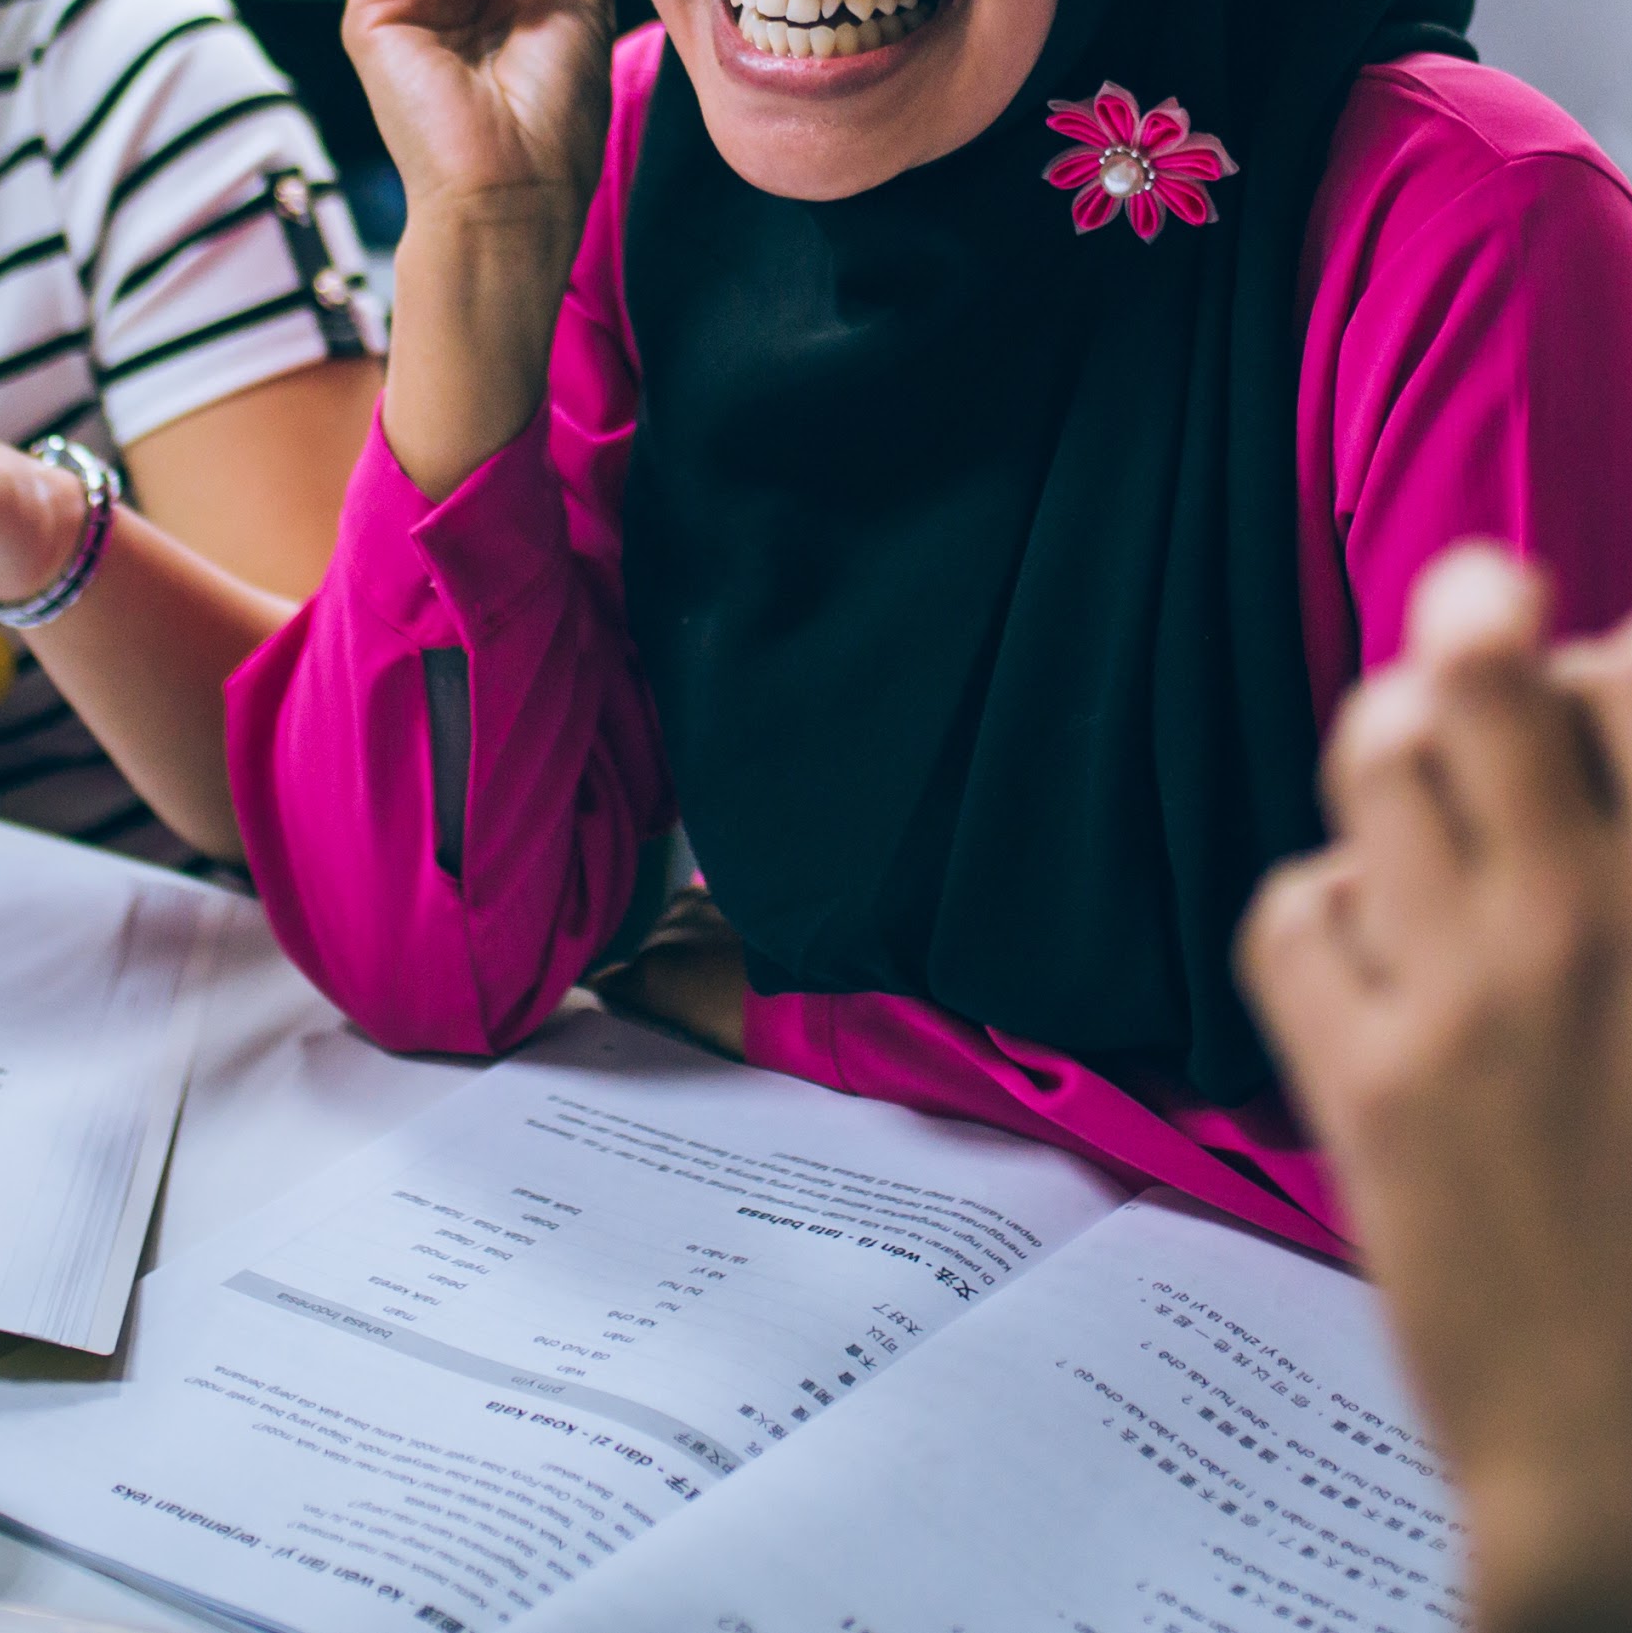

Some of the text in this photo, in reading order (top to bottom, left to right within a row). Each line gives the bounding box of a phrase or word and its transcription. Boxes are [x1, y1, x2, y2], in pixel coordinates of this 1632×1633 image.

[736, 1206, 806, 1230] bahasa
[806, 1224, 844, 1239] tata
[1004, 1219, 1043, 1248] depan
[410, 1243, 452, 1261] mobil
[924, 1238, 984, 1273] pelajaran
[952, 1230, 1013, 1273] kami ingin
[367, 1275, 412, 1297] kereta
[427, 1272, 469, 1291] pelan
[934, 1266, 980, 1302] 文法
[978, 1271, 996, 1286] Di
[275, 1292, 342, 1321] Indonesia
[410, 1291, 442, 1306] naik
[382, 1305, 418, 1322] main
[872, 1303, 924, 1337] 太好了
[341, 1315, 394, 1340] bahasa
[865, 1325, 899, 1355] 可以
[485, 1400, 529, 1420] kata
[529, 1413, 579, 1436] kosa
[1395, 1453, 1440, 1477] Guru
[110, 1484, 262, 1549] terjemahan teks
